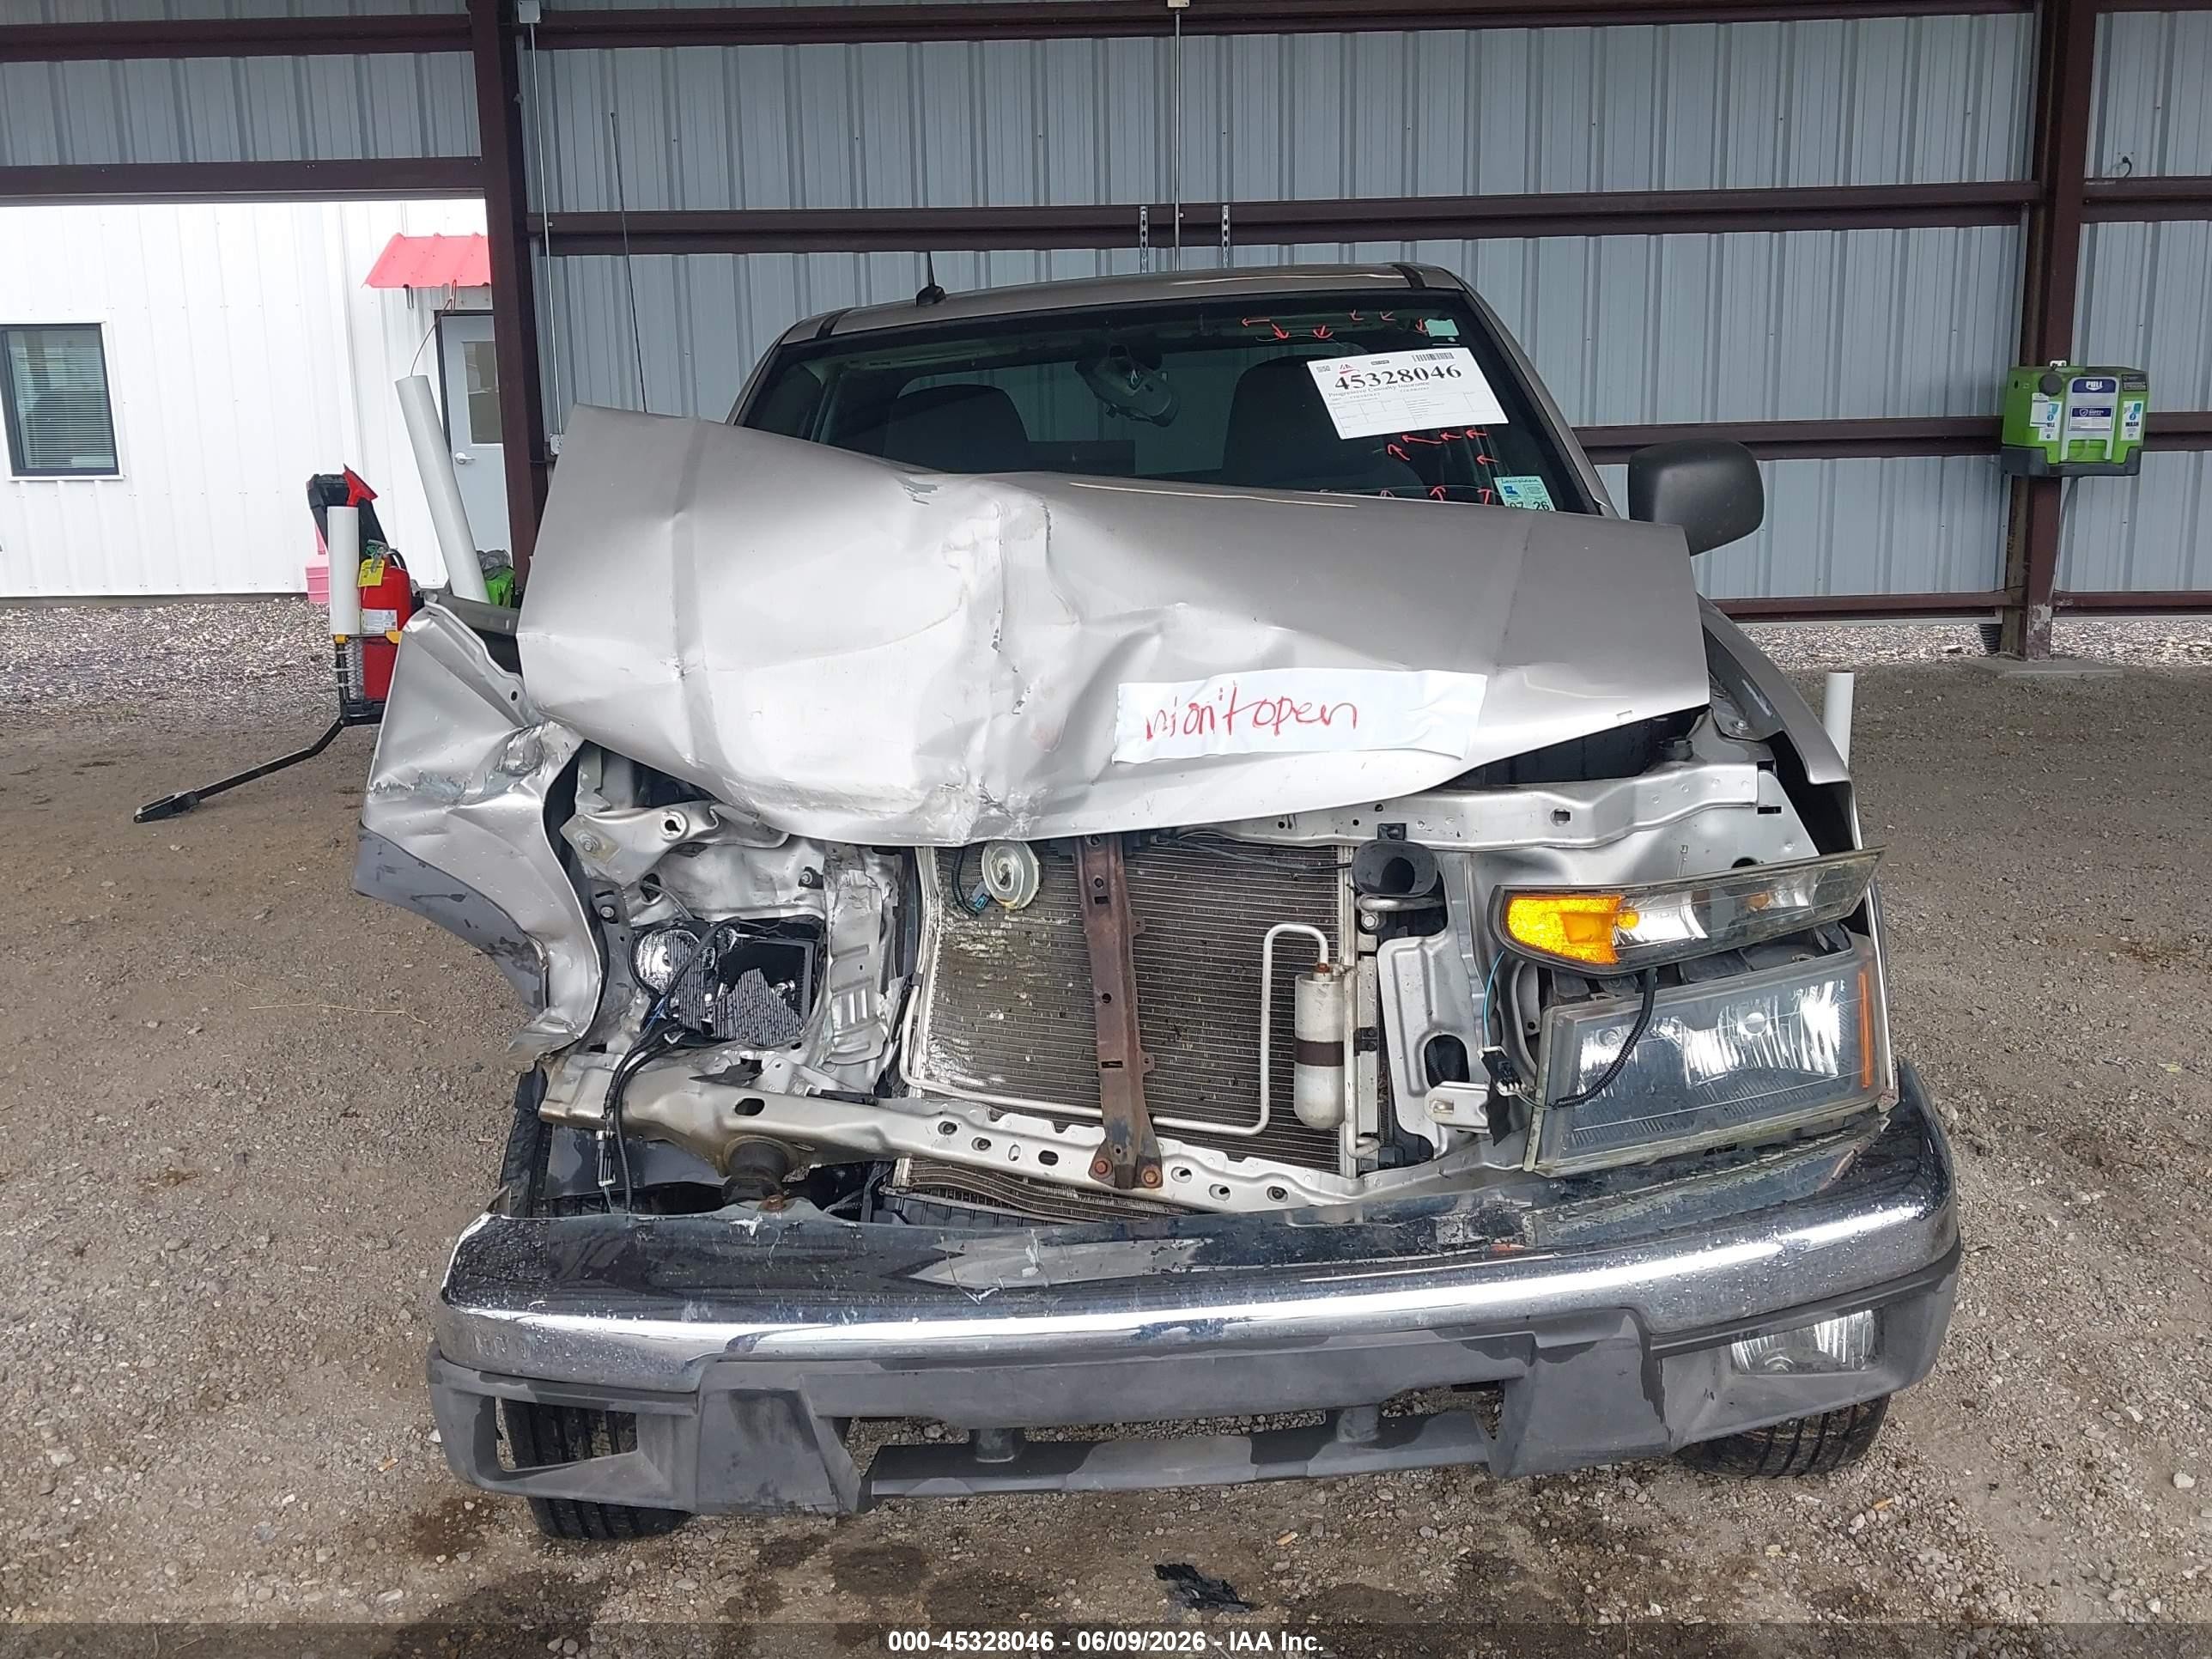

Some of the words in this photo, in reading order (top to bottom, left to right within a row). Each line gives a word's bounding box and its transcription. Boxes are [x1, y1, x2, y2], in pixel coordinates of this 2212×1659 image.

[1334, 363, 1462, 390] 45328046
[2085, 380, 2103, 389] PULL
[1251, 697, 1358, 737] open
